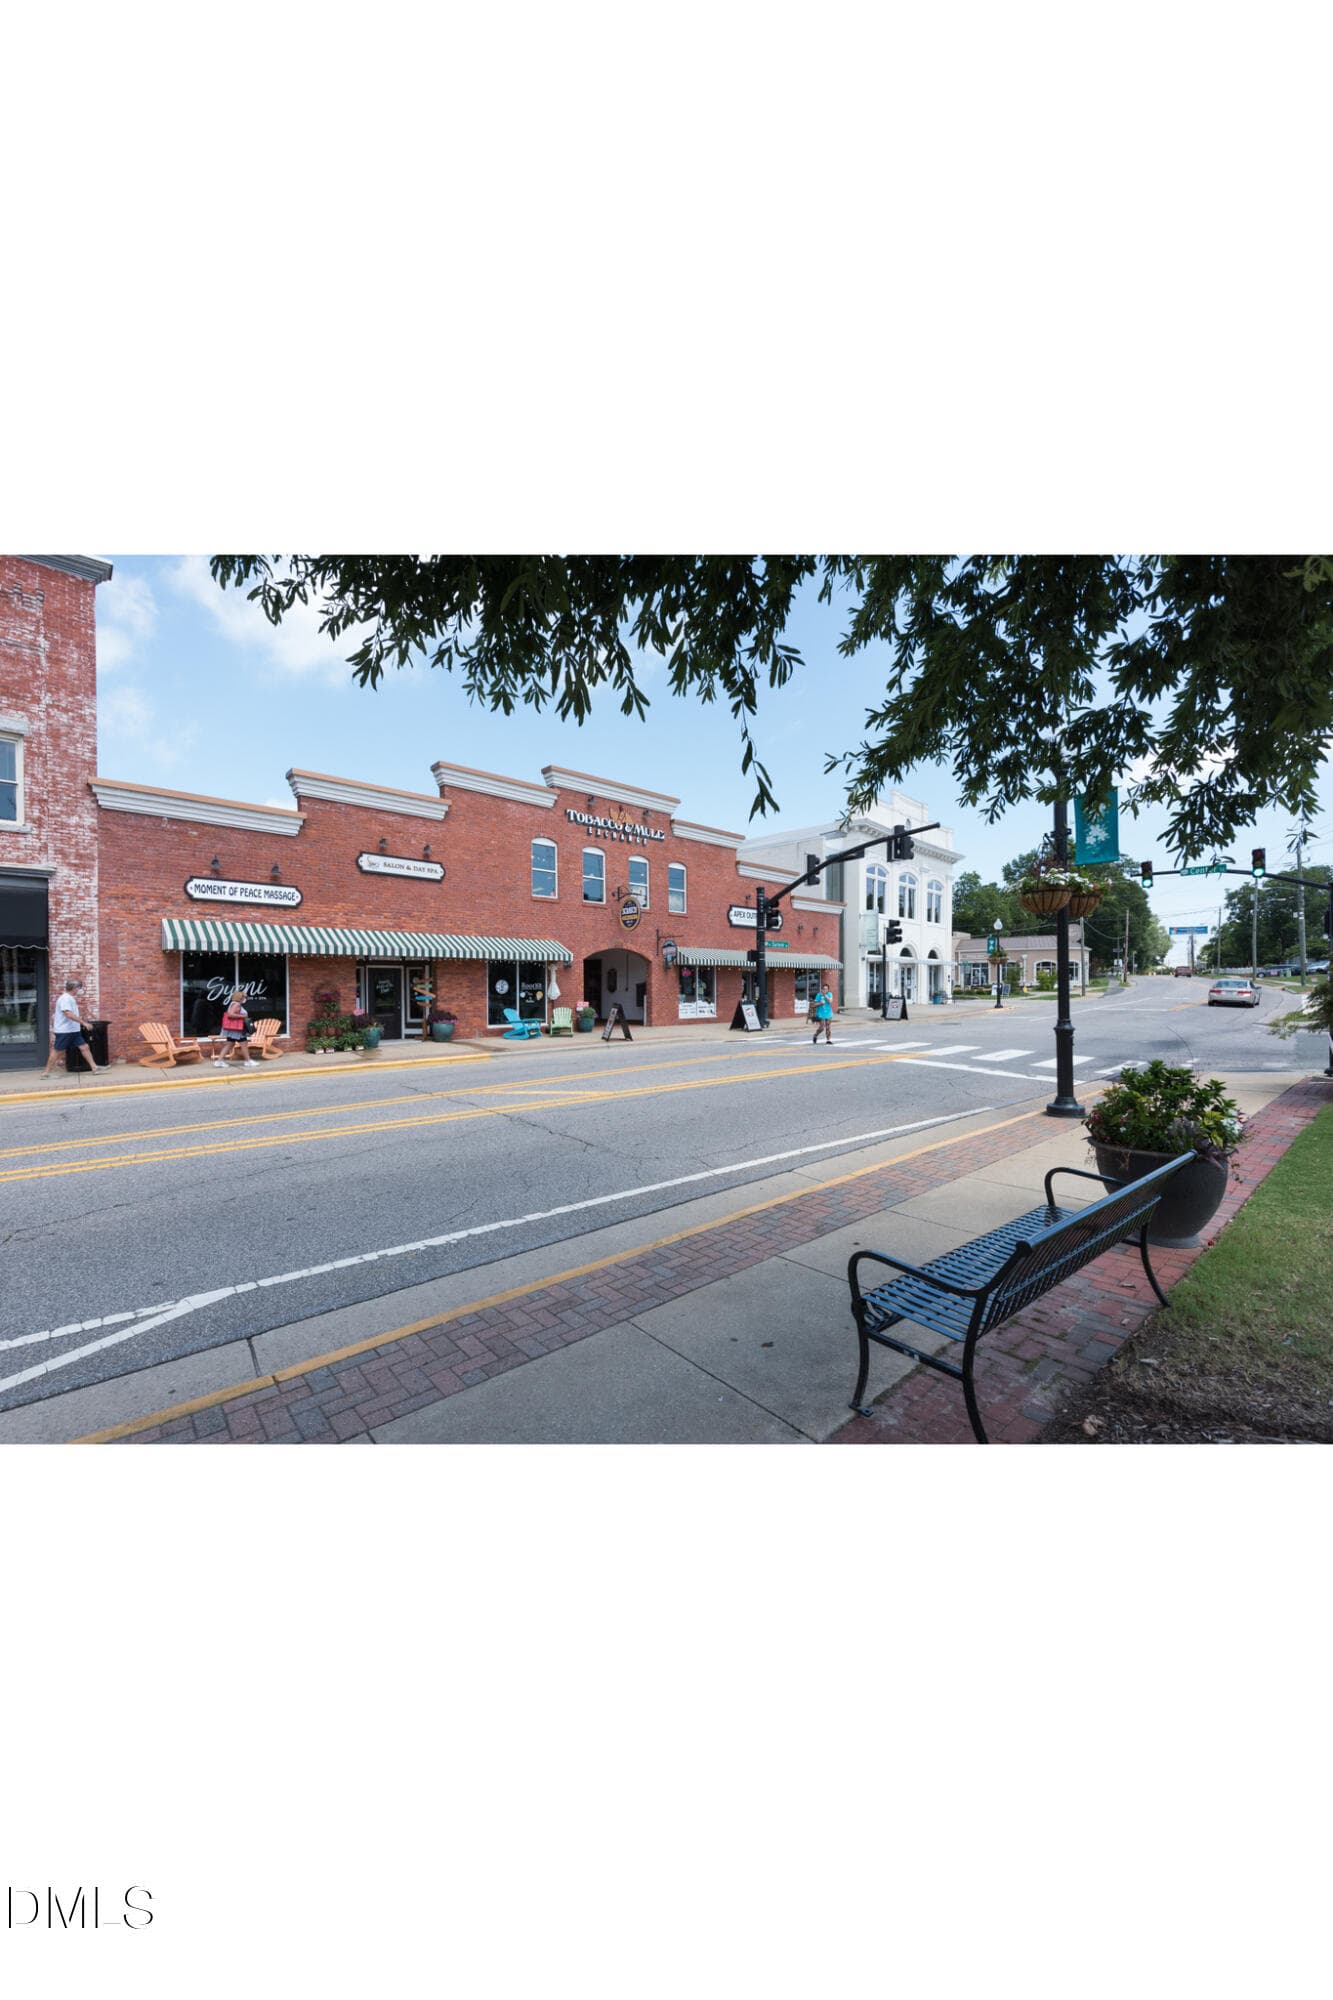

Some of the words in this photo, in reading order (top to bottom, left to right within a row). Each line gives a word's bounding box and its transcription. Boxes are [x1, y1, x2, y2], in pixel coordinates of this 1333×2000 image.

[565, 809, 623, 831] TOBACCO
[633, 824, 665, 841] MULE
[383, 861, 405, 870] SALON
[413, 864, 426, 874] DAY
[427, 867, 439, 875] SPA
[194, 883, 227, 896] MOMENT
[228, 886, 238, 896] OF
[239, 888, 262, 899] PEACE
[263, 890, 296, 901] MASSAGE
[734, 910, 746, 919] APEX
